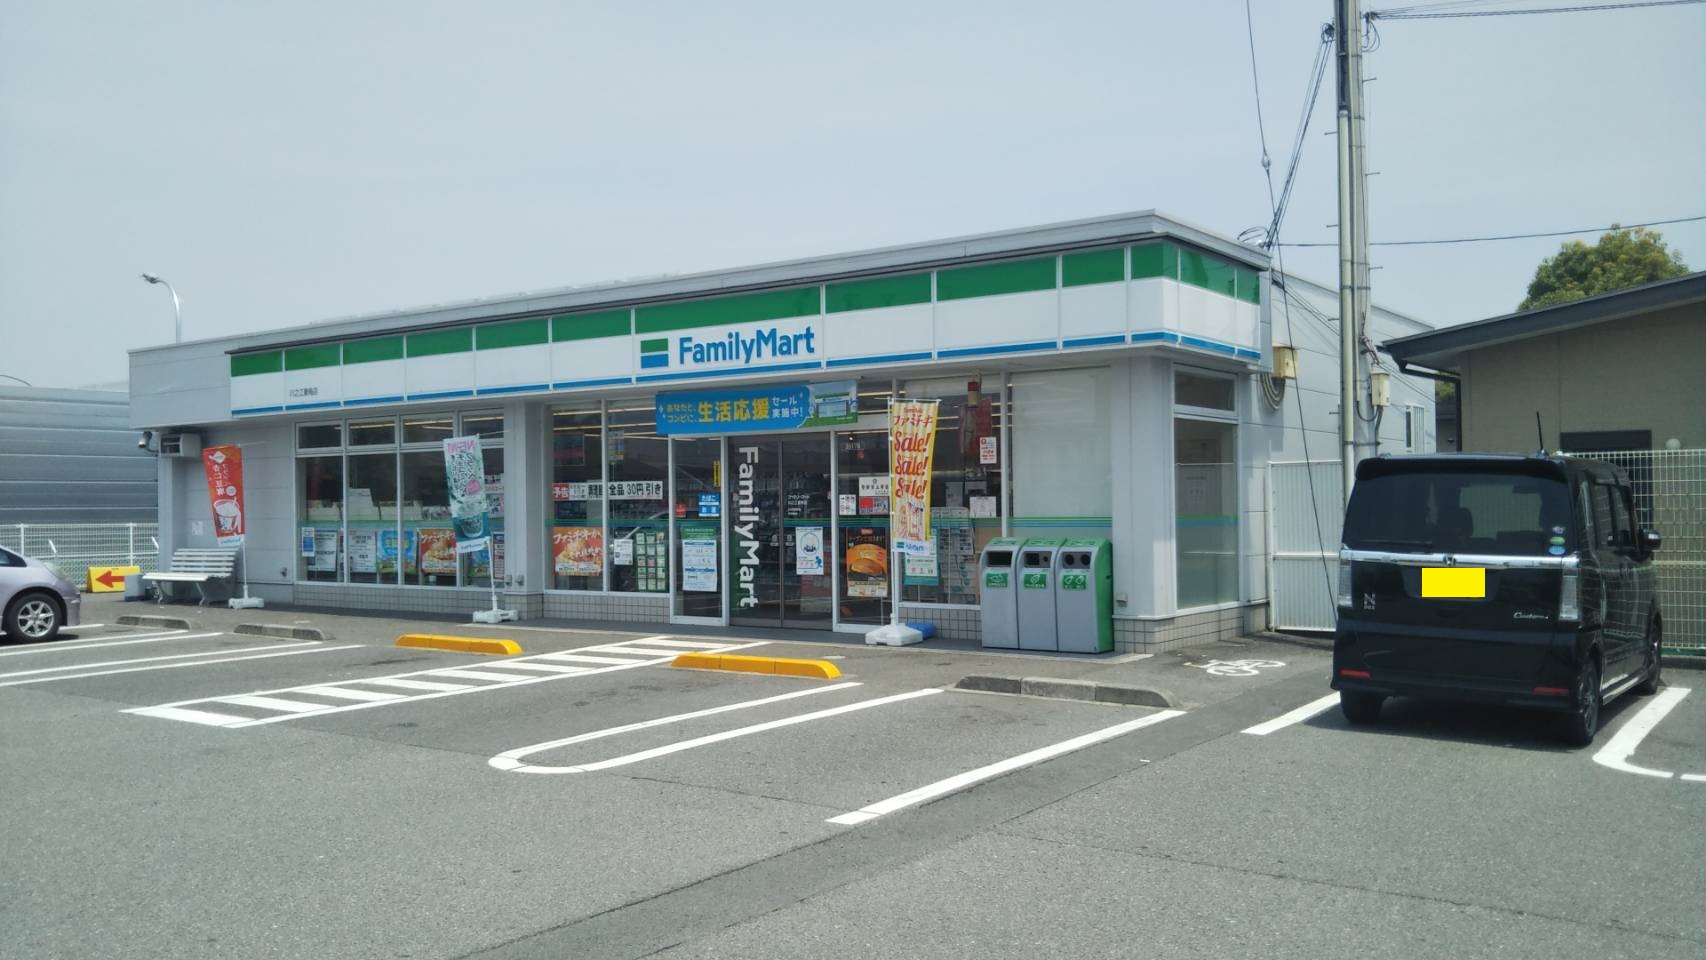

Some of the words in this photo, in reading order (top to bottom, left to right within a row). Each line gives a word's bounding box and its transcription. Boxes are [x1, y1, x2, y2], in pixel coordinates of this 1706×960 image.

[679, 326, 815, 364] FamilyMart
[698, 397, 770, 422] 生活応援
[772, 395, 797, 405] セール
[894, 431, 932, 453] Sale!
[895, 454, 929, 476] Sale!
[734, 446, 760, 608] FamilyMart
